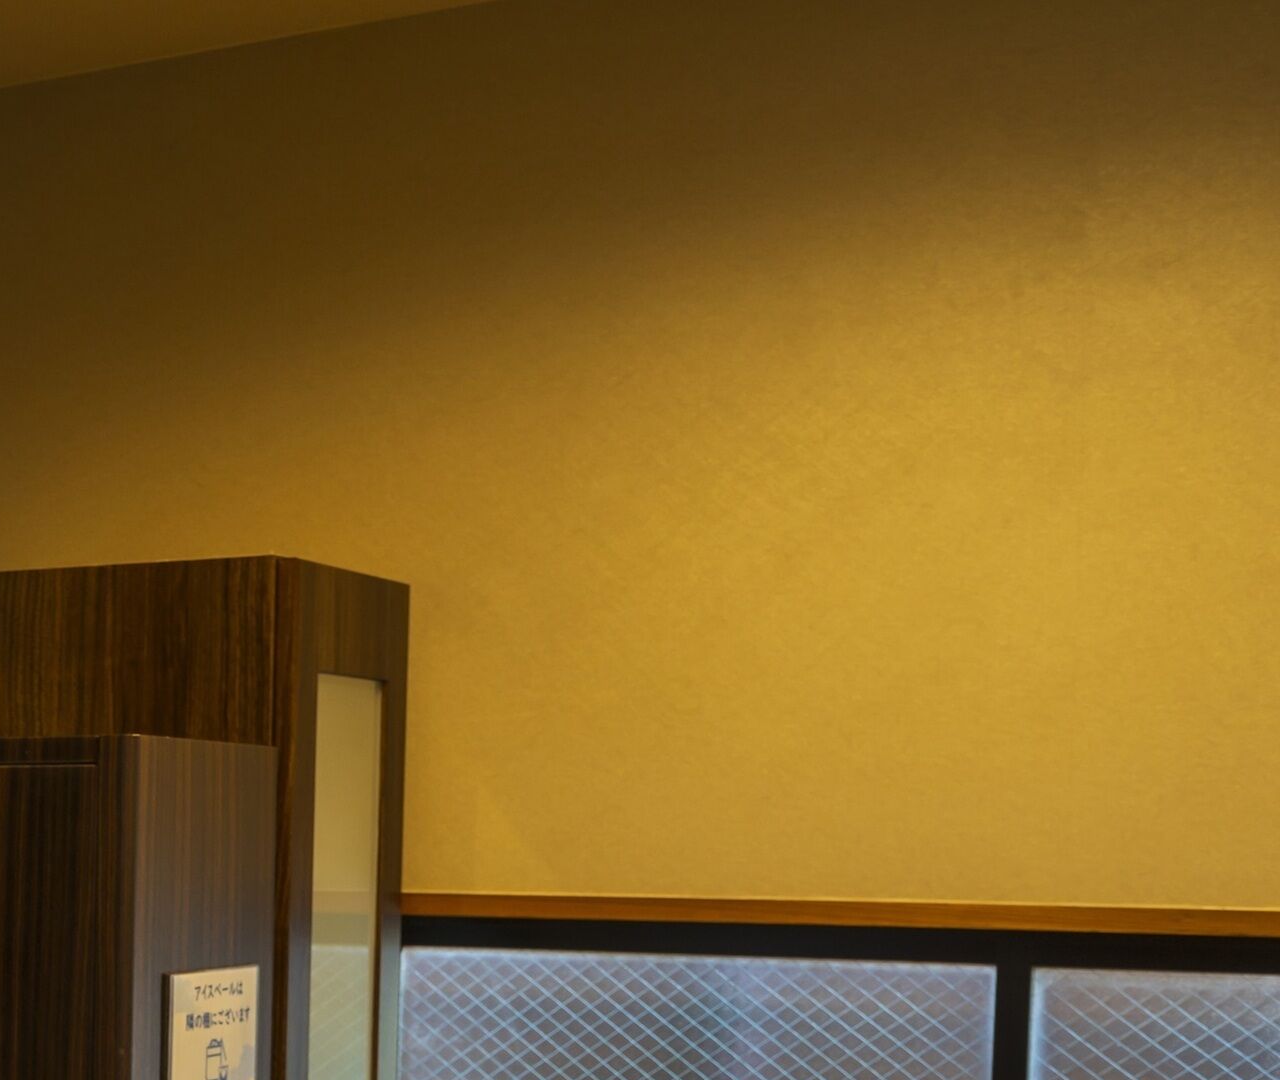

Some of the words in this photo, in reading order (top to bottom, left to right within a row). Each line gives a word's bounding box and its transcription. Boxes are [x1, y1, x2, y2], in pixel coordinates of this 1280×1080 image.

[194, 982, 244, 1001] アイスペールは
